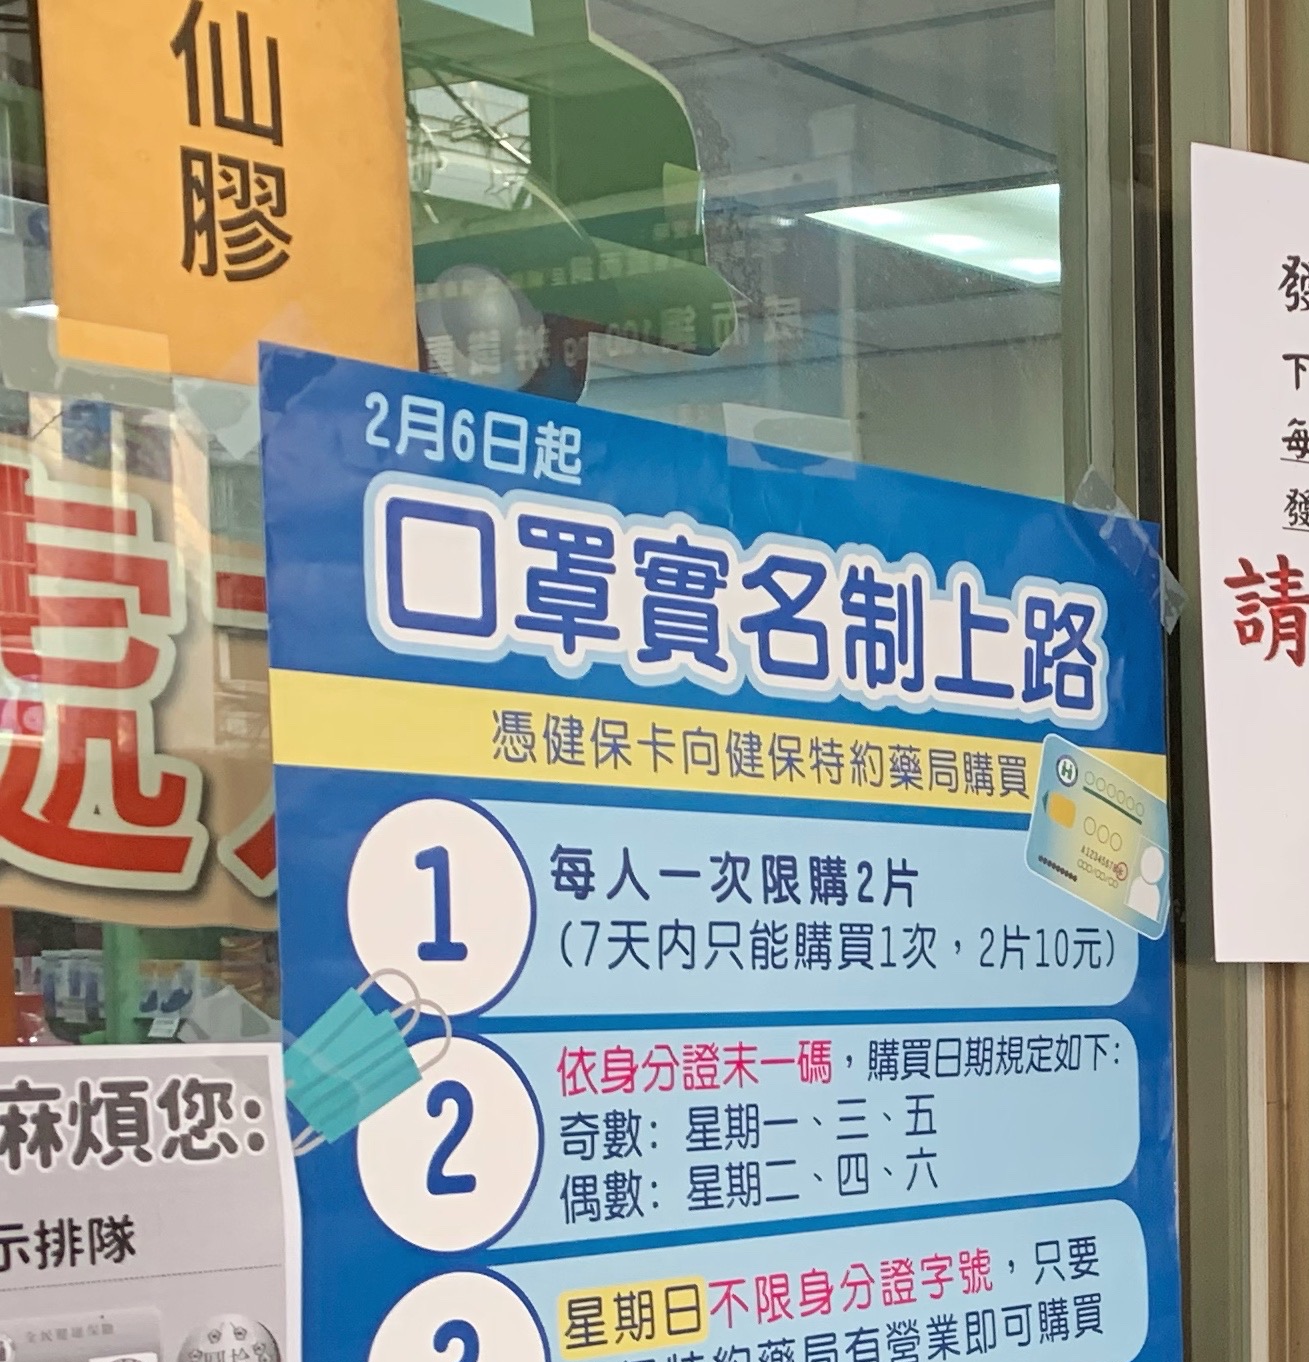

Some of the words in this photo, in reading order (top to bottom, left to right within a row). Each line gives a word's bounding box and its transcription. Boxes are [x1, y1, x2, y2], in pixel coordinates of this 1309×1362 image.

[170, 0, 294, 283] 仙膠
[364, 391, 583, 486] 2月6日起
[380, 492, 1100, 714] 口罩實名制上路
[490, 707, 1030, 801] 憑健保卡向健保特約藥局購買
[413, 845, 468, 963] 1
[549, 843, 920, 909] 每人一次限購2片
[425, 1078, 477, 1198] 2
[563, 1235, 1101, 1352] 星期日不限身分證字號，只要
